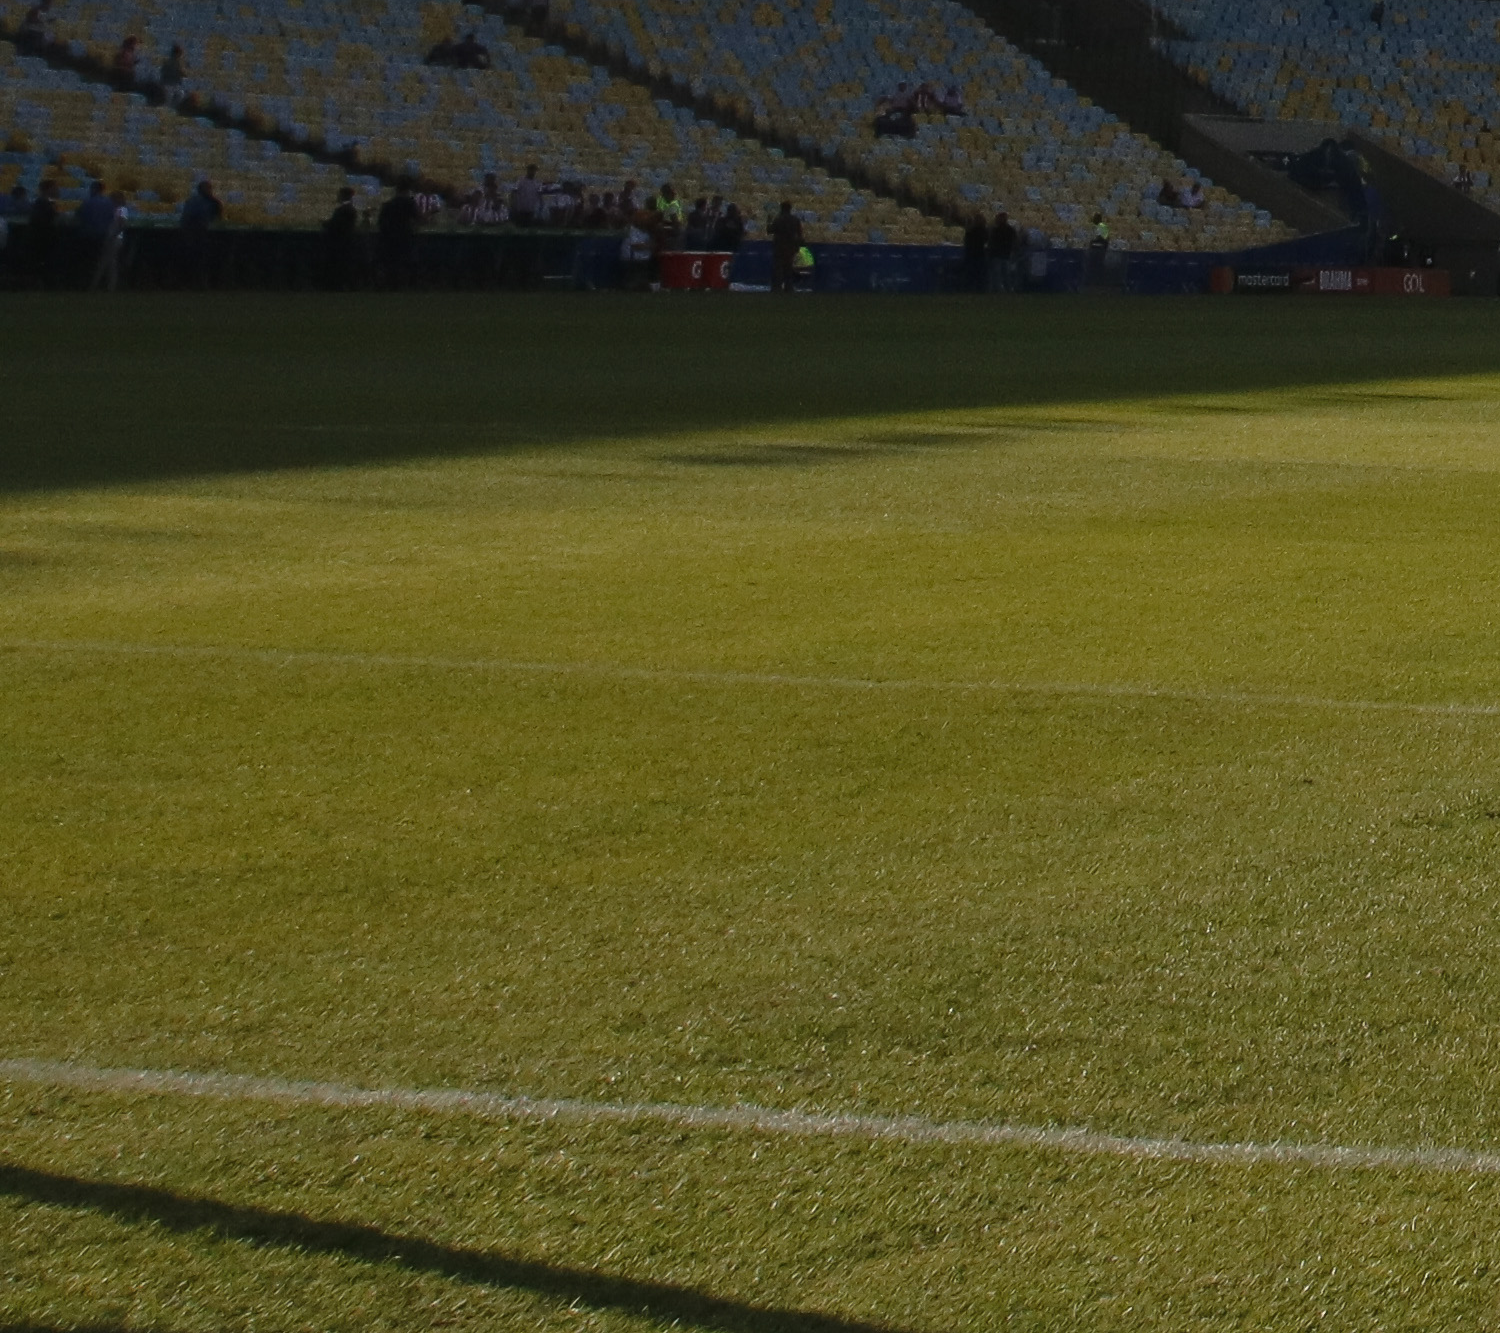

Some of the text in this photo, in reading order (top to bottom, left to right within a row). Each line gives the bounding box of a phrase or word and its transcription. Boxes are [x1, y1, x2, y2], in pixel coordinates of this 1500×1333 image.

[691, 260, 702, 280] G
[1238, 273, 1290, 287] mastercard
[1319, 269, 1352, 291] BRAHMA
[1403, 273, 1425, 294] GOL
